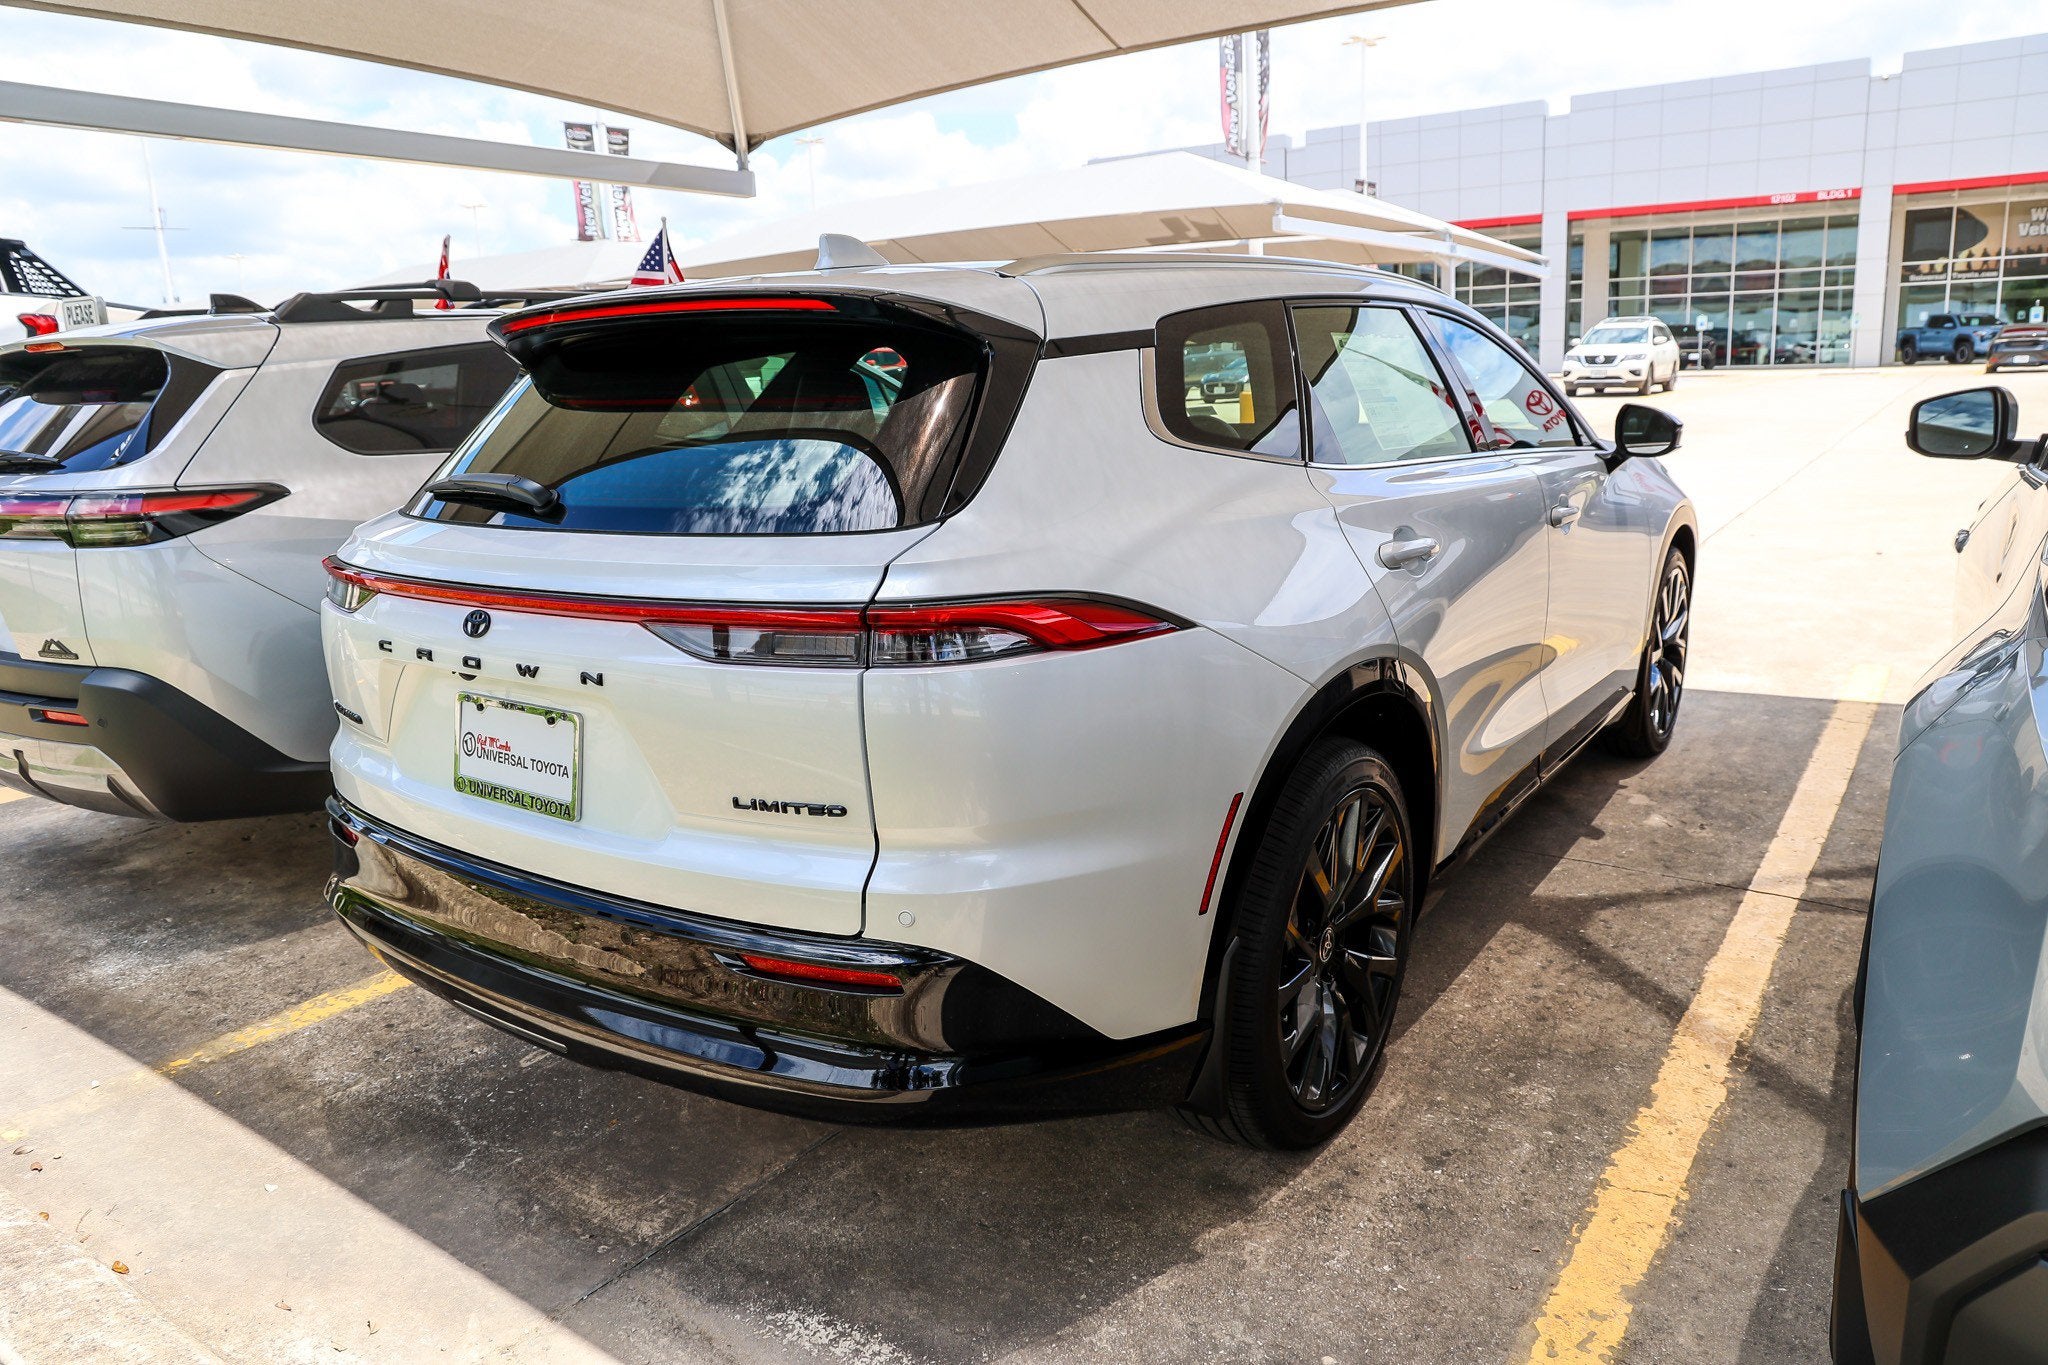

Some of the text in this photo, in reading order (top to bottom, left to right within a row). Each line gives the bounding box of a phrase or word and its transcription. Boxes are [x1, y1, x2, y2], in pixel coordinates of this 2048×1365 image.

[583, 206, 597, 236] New
[2018, 222, 2048, 237] Vet
[66, 304, 95, 326] PLEASE
[378, 639, 605, 687] CROWN
[477, 746, 569, 779] UNIVERSAL TOYOTA
[468, 779, 571, 818] UNIVERSAL TOYOTA
[732, 796, 848, 817] LIMITED
